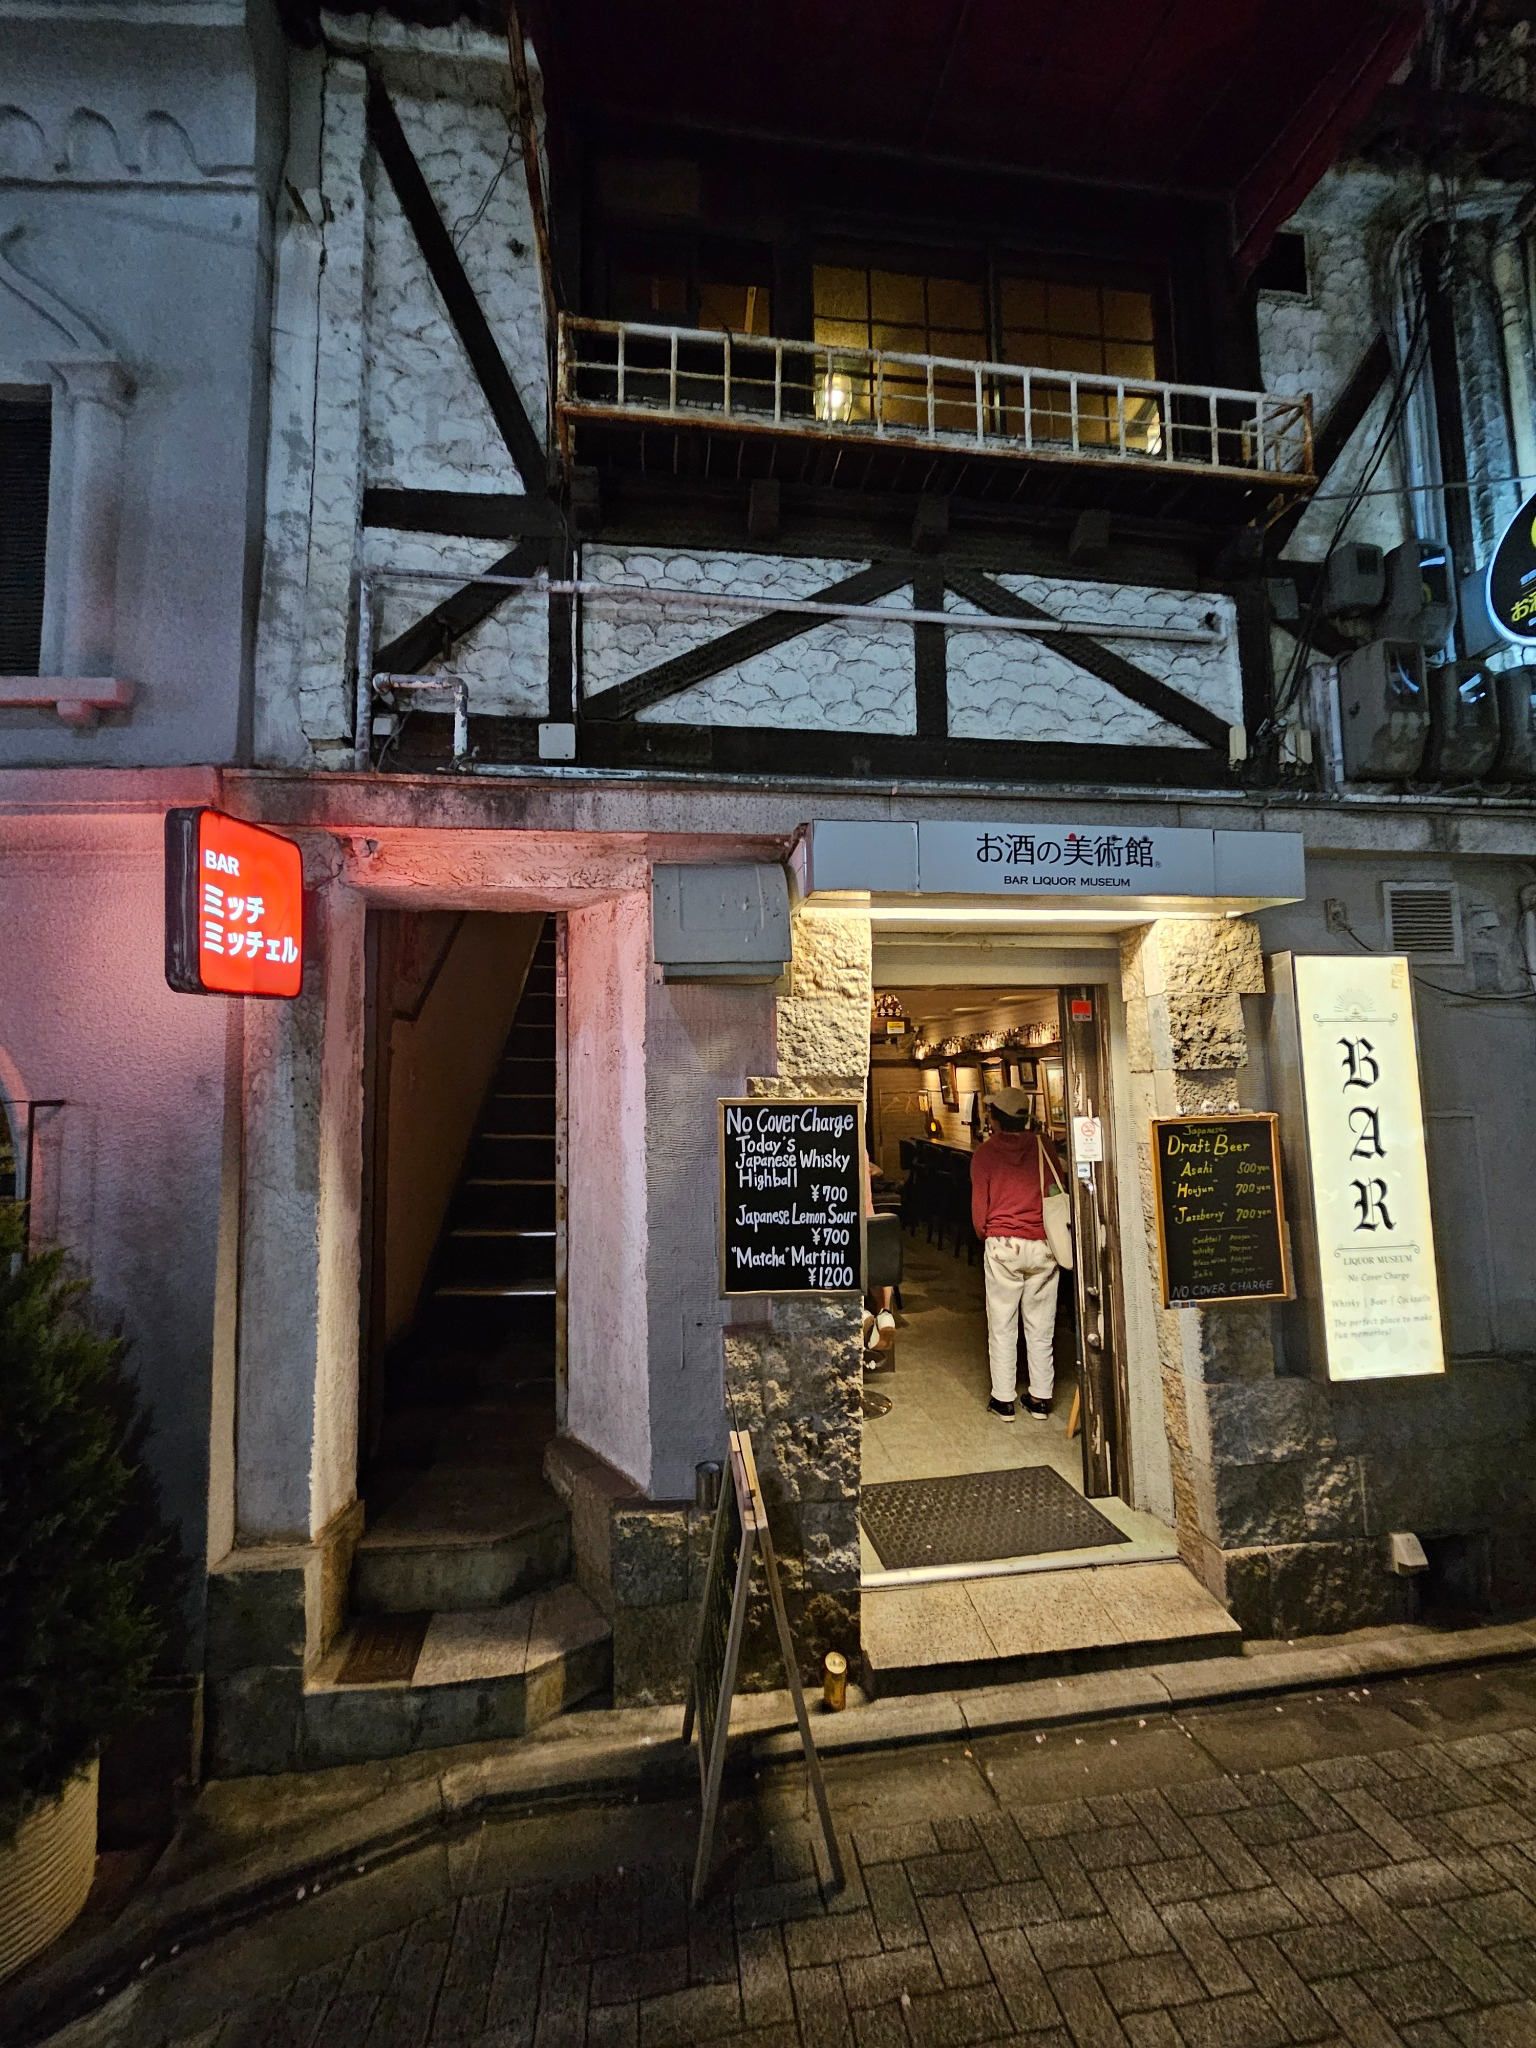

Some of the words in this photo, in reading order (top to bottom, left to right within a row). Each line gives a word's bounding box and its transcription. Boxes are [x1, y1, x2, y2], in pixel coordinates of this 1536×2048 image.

[977, 832, 1154, 868] お酒の美術館
[205, 849, 240, 877] BAR
[1004, 876, 1028, 885] BAR
[1032, 876, 1076, 886] LIQUOR
[1080, 877, 1130, 888] MUSEUM
[204, 883, 265, 924] ミッチ
[204, 921, 299, 964] ミッチェル
[727, 1107, 752, 1135] No
[757, 1108, 799, 1133] Cover
[800, 1107, 853, 1138] Charge
[1336, 1035, 1397, 1232] BAR
[736, 1134, 795, 1155] Today's
[1166, 1134, 1211, 1156] Draft
[1213, 1134, 1251, 1156] Beer
[735, 1152, 796, 1173] Japanese
[800, 1149, 850, 1172] Whisky
[739, 1168, 798, 1191] Highball
[736, 1204, 790, 1233] Japanese
[792, 1202, 826, 1225] Lemon
[828, 1203, 857, 1225] Sour
[791, 1245, 845, 1267] Martini
[1343, 1257, 1375, 1266] LIQUOR
[1377, 1255, 1412, 1264] MUSEUM
[808, 1266, 854, 1287] ¥1200
[1348, 1274, 1359, 1282] No
[1361, 1273, 1382, 1281] Cover
[1383, 1272, 1410, 1281] Charge
[1172, 1285, 1189, 1299] NO
[1192, 1283, 1226, 1296] COVER
[1230, 1280, 1273, 1293] CHARGE
[1332, 1299, 1360, 1308] Whisky
[1370, 1298, 1387, 1306] Beer
[1349, 1317, 1378, 1328] perfect
[1380, 1316, 1400, 1325] place
